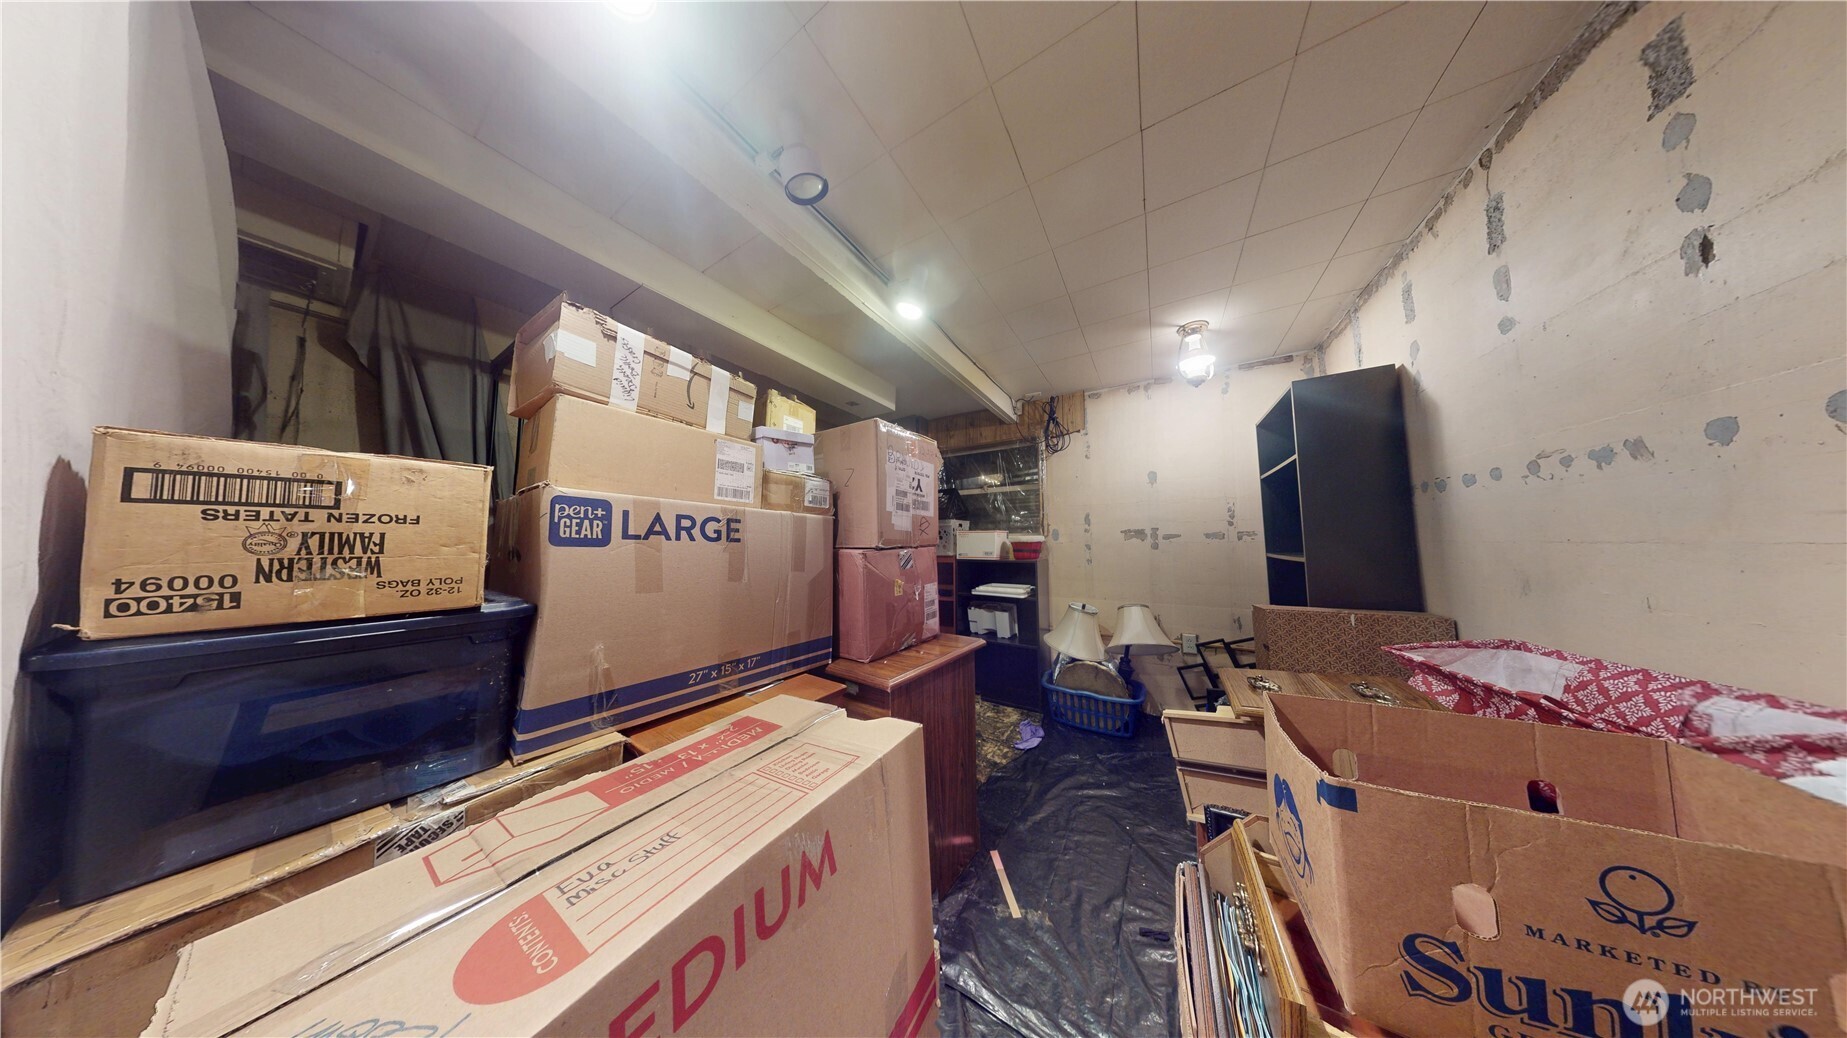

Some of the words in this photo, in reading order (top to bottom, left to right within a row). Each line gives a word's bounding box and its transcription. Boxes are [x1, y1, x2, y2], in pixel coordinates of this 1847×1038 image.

[153, 461, 162, 469] 9
[176, 463, 225, 473] 00094
[236, 467, 281, 477] 15400
[291, 471, 307, 479] 00
[200, 508, 315, 523] TATERS
[326, 512, 420, 525] FROZEN
[559, 518, 603, 539] GEAR
[621, 510, 741, 543] LARGE
[294, 531, 386, 556] FAMILY
[253, 555, 382, 584] WESTERN
[111, 574, 238, 595] 00094
[376, 579, 421, 590] BAGS
[426, 576, 463, 586] POLY
[396, 588, 421, 598] OZ.
[426, 586, 462, 596] 12-32
[108, 593, 237, 616] 15400
[710, 670, 717, 678] x
[738, 663, 744, 671] x
[619, 767, 675, 795] MEDIO
[394, 826, 431, 853] TAPE
[566, 869, 626, 906] Misc
[628, 830, 682, 864] Stuff
[508, 911, 558, 975] CONTENTS:
[1523, 923, 1722, 986] MARKETED
